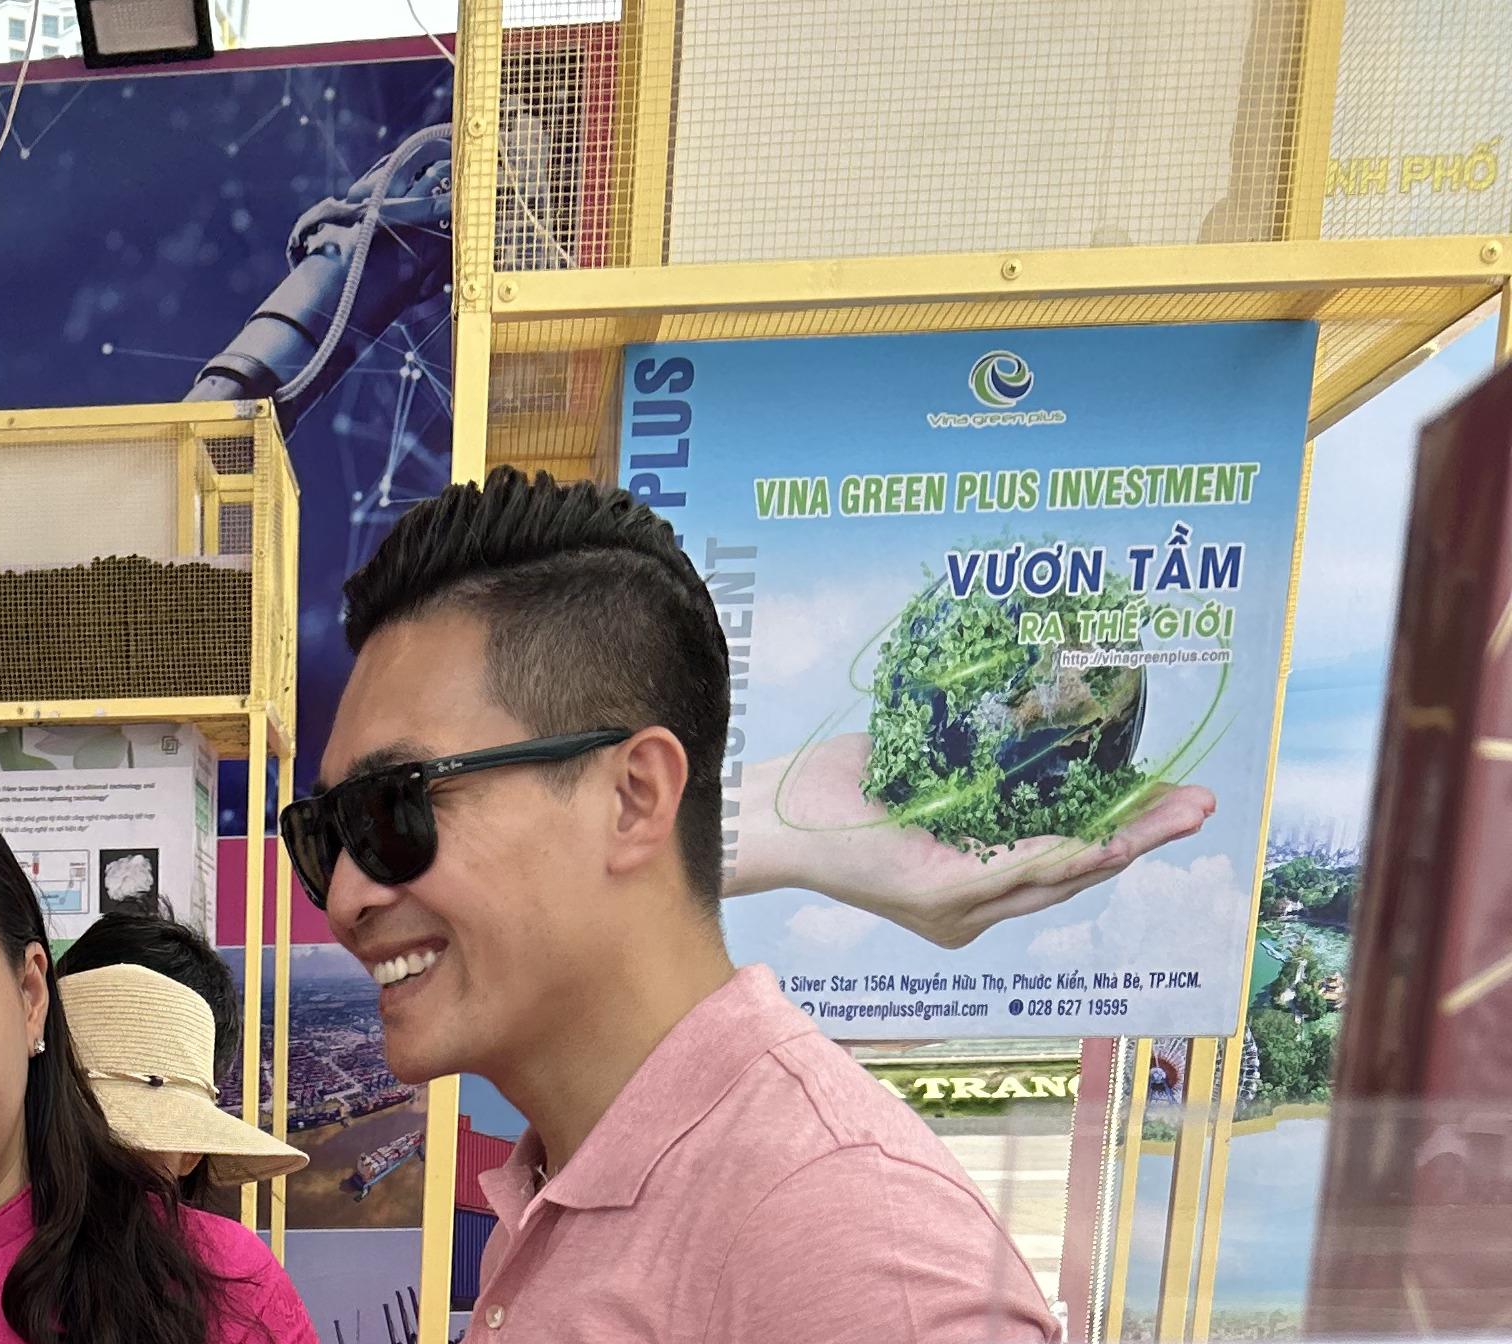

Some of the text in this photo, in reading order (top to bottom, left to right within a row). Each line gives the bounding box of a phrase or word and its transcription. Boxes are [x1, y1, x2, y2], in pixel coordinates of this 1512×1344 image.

[629, 357, 695, 507] PLUS
[756, 463, 1259, 518] VINA GREEN PLUS INVESTMENT
[946, 521, 1244, 599] VƯƠN TẦM
[1019, 601, 1235, 645] RA THẾ GIỚI
[1060, 649, 1230, 669] http://vinagreenplus.com
[791, 975, 826, 992] Silver
[831, 975, 857, 992] Star
[864, 975, 895, 991] 156A
[900, 972, 947, 995] Nguyễn
[952, 974, 977, 991] Hữu
[982, 973, 1008, 993] Thọ,
[1093, 972, 1118, 989] Nhà
[1149, 972, 1202, 989] TP.HCM.
[819, 1000, 988, 1021] Vinagreenpluss@gmail.com
[1028, 998, 1128, 1016] 028 627 19595
